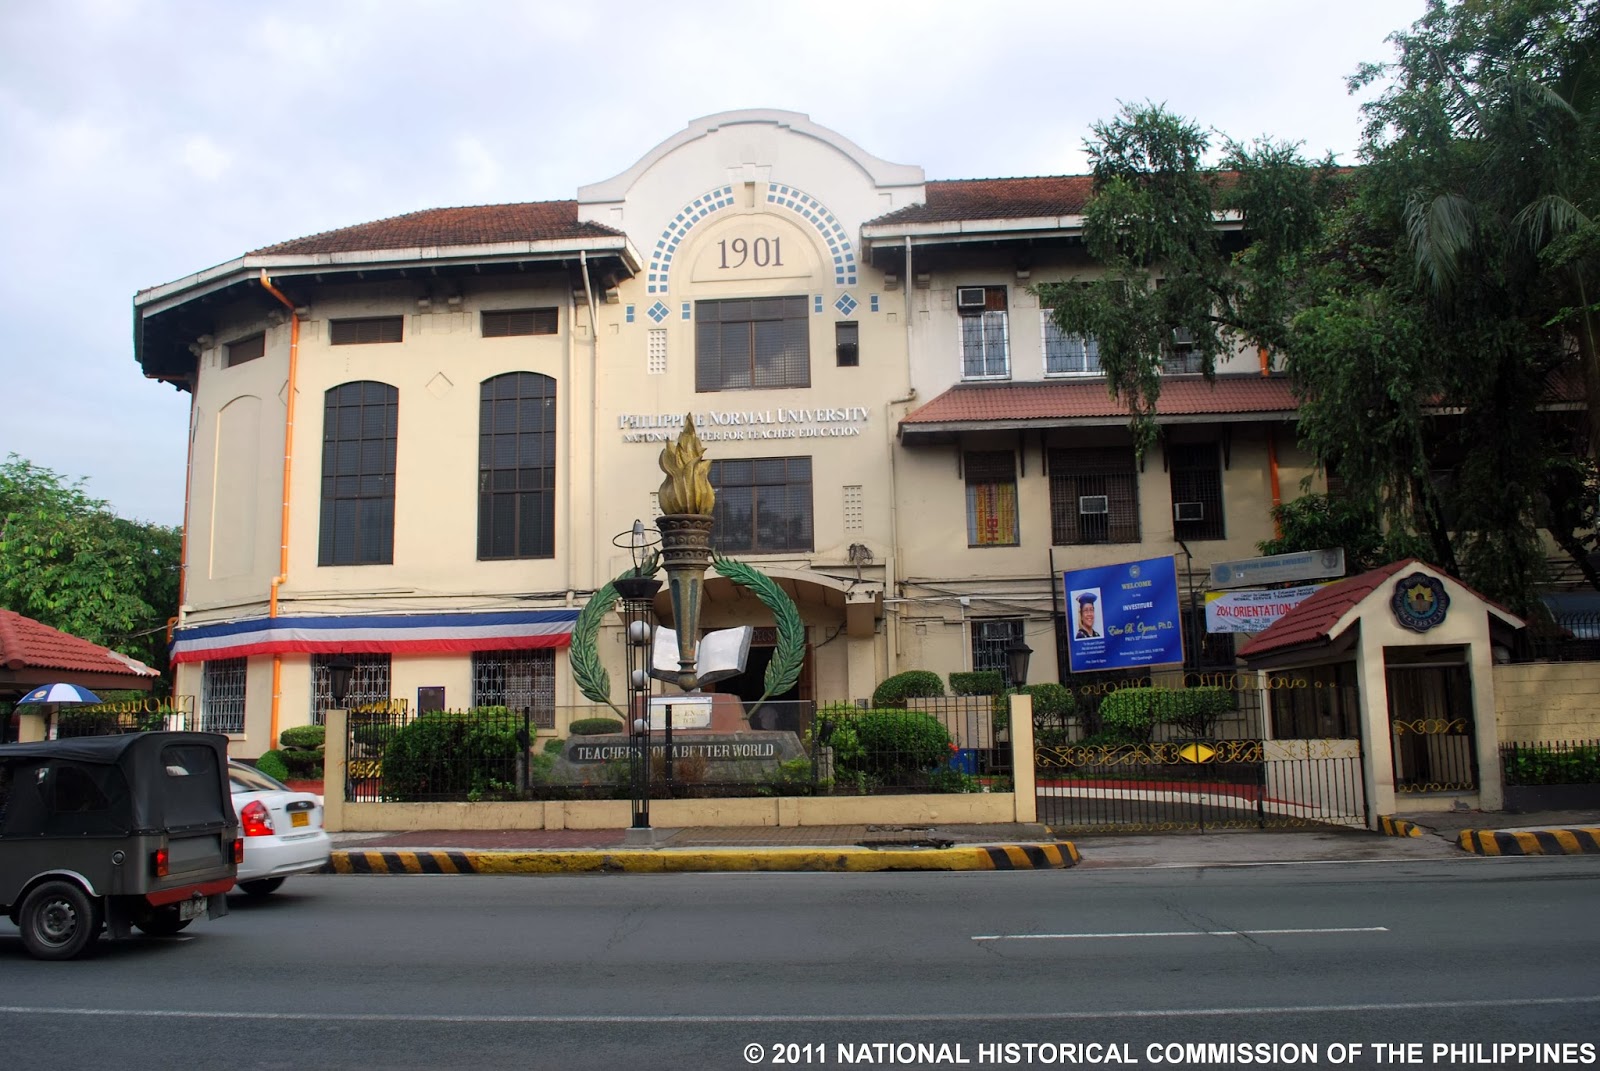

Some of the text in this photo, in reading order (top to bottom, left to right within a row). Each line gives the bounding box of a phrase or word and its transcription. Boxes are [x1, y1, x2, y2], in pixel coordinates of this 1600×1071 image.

[717, 236, 785, 270] 1901
[619, 407, 871, 429] PHILIPPIE NORMAL UNIVERSITY
[723, 430, 744, 442] FOR
[747, 428, 796, 440] TEACHER
[799, 426, 860, 439] EDUCATION
[1121, 580, 1152, 590] WELCOME
[1122, 601, 1153, 611] INVESTITURE
[1233, 603, 1291, 617] ORIENTATION
[681, 743, 730, 759] BETTER
[732, 743, 775, 757] WORLD
